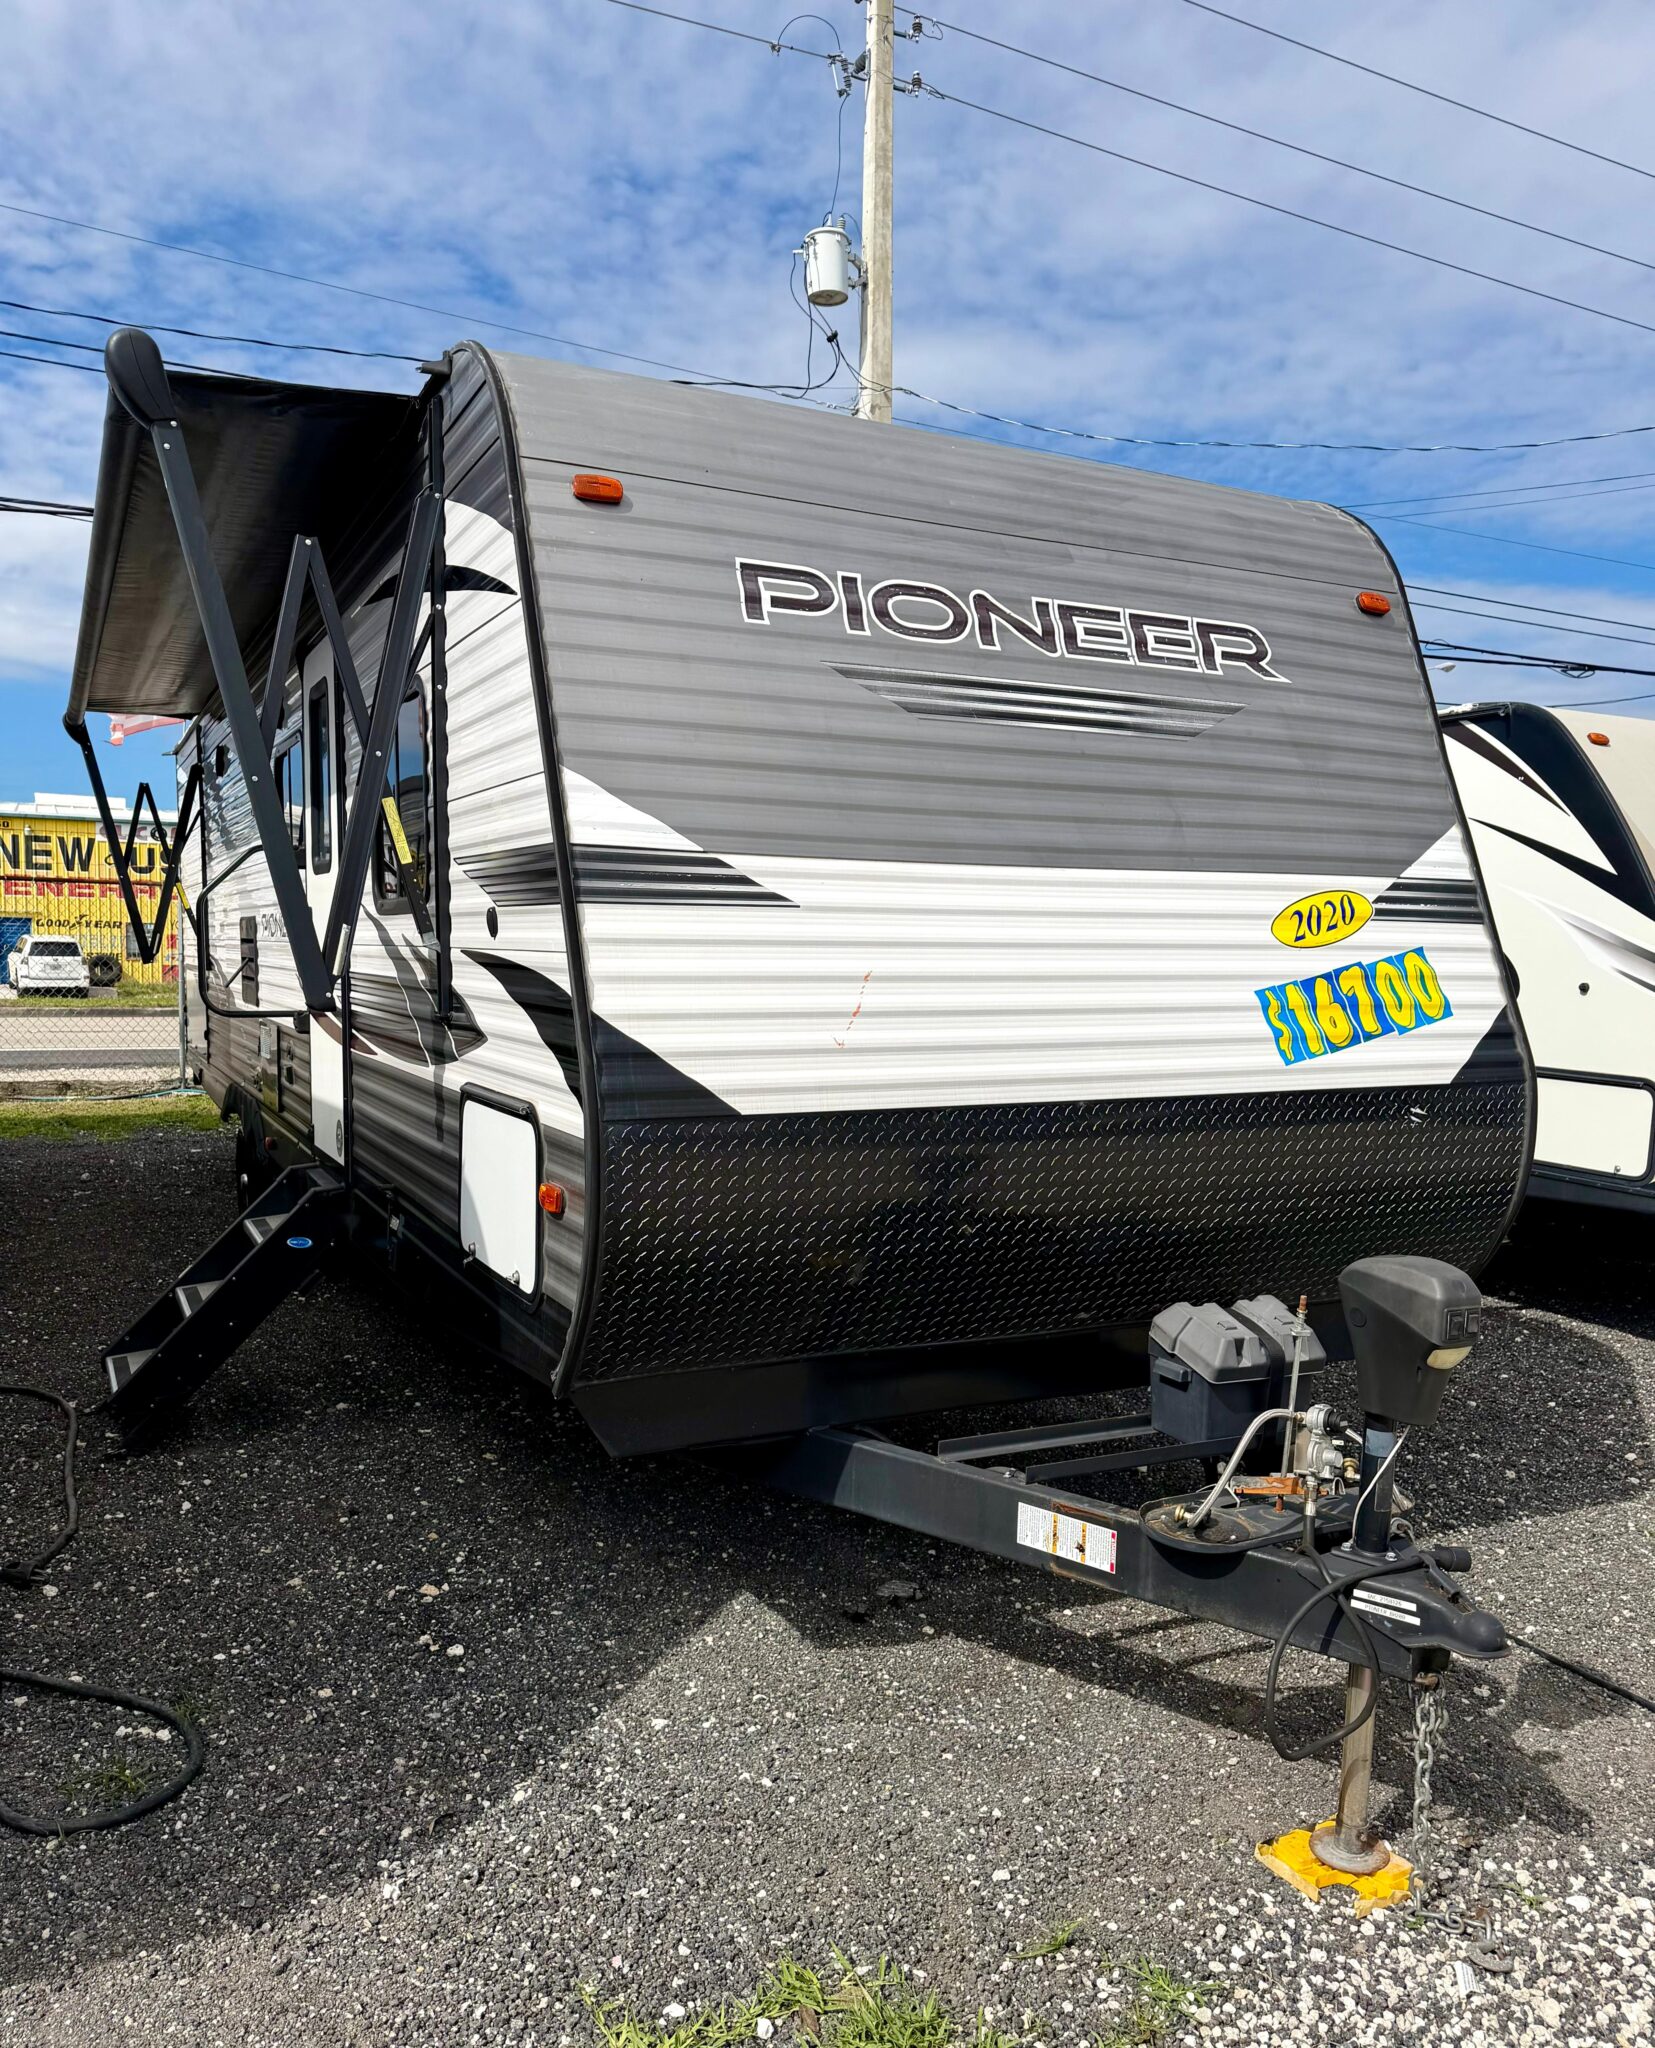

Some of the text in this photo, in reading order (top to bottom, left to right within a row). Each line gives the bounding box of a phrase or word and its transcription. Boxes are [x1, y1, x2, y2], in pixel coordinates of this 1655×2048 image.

[735, 557, 1291, 683] PIONEER
[0, 834, 95, 872] NEW
[1290, 894, 1355, 942] 2020
[1265, 951, 1445, 1062] $16700
